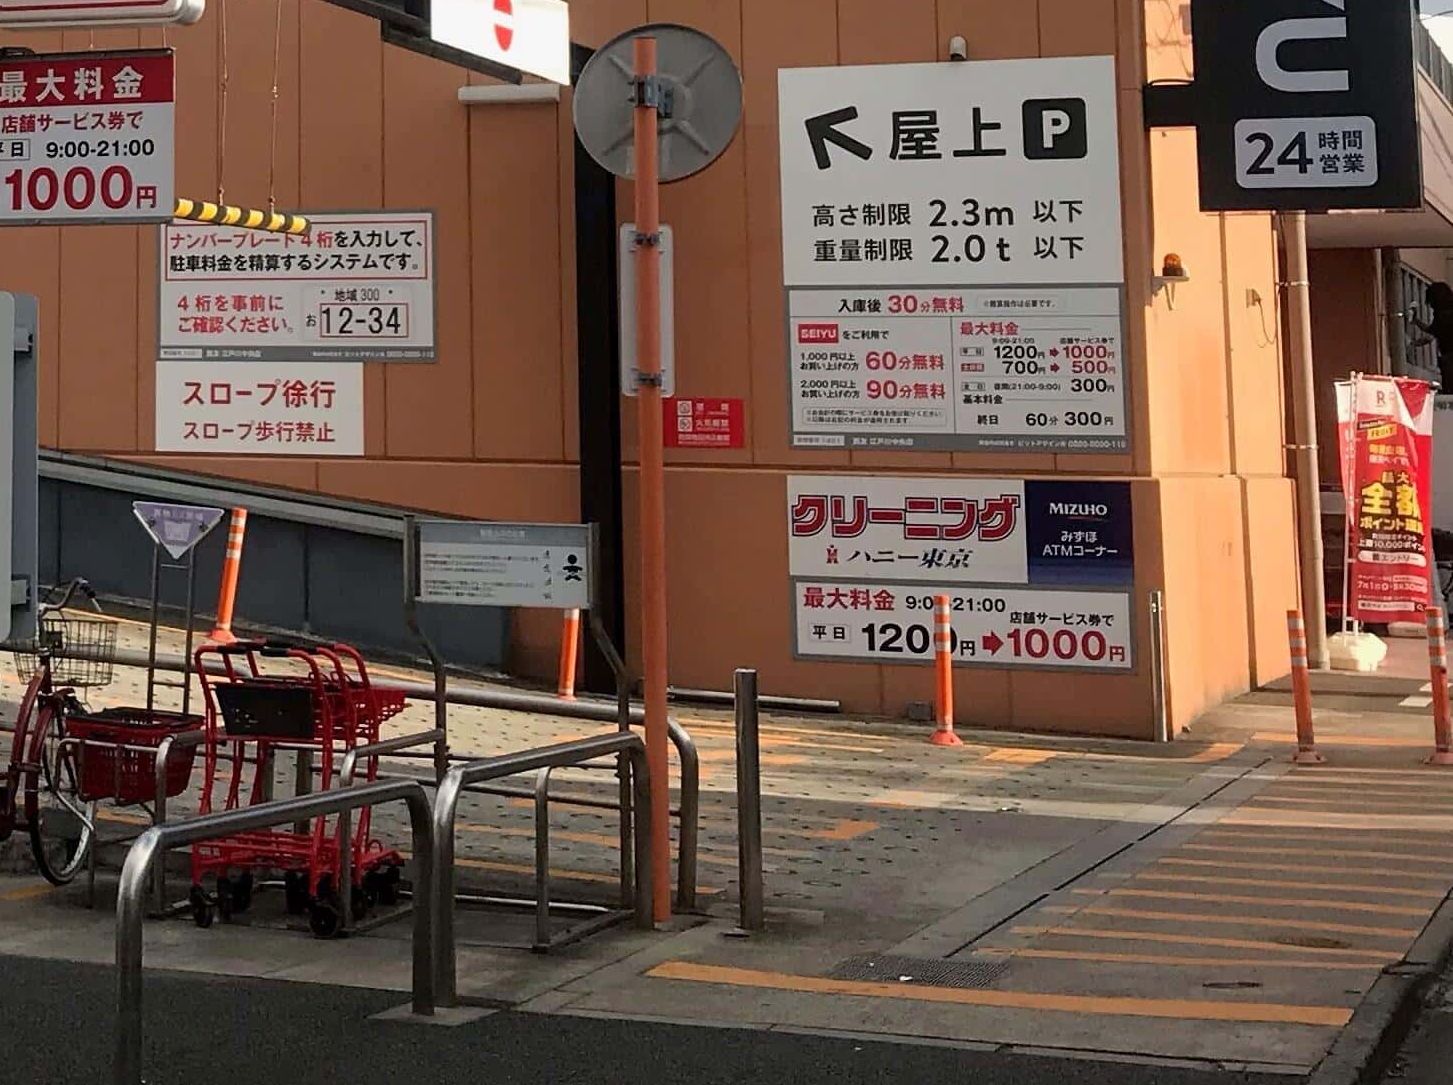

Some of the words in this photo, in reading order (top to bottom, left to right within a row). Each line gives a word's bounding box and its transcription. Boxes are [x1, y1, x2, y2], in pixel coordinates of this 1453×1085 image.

[2, 110, 144, 134] 店舗サービス券で
[889, 107, 1007, 161] 屋上
[46, 139, 155, 158] 9:00-21:00
[1245, 131, 1313, 175] 24
[1319, 130, 1363, 150] 時間
[1319, 154, 1365, 174] 営業
[5, 165, 157, 211] 1000円
[812, 203, 912, 228] 高さ制限
[929, 198, 1014, 227] 2.3m
[1033, 200, 1083, 224] 以下
[813, 238, 913, 262] 重量制限
[1033, 236, 1084, 260] 以下
[170, 253, 419, 272] 駐車料金を精算するシステムです。
[838, 298, 881, 313] 入庫後
[178, 316, 294, 334] ご確認ください。
[321, 307, 401, 334] 12-34
[960, 321, 1019, 336] 最大料金
[800, 328, 837, 339] SEIYU
[865, 351, 944, 371] 60分無料
[183, 378, 336, 408] スロープ徐行
[866, 380, 945, 400] 90分無料
[183, 421, 336, 443] スロープ歩行禁止
[792, 494, 1021, 542] クリーニング
[1049, 502, 1108, 516] MIZUHO
[1060, 530, 1098, 543] みずほ
[847, 548, 974, 569] ハニー東京
[1042, 544, 1118, 558] ATMコーナー
[803, 587, 896, 612] 最大料金
[905, 595, 1006, 613] 9:021:00
[1009, 611, 1114, 627] 店舗サービス券で
[812, 625, 846, 640] 平日
